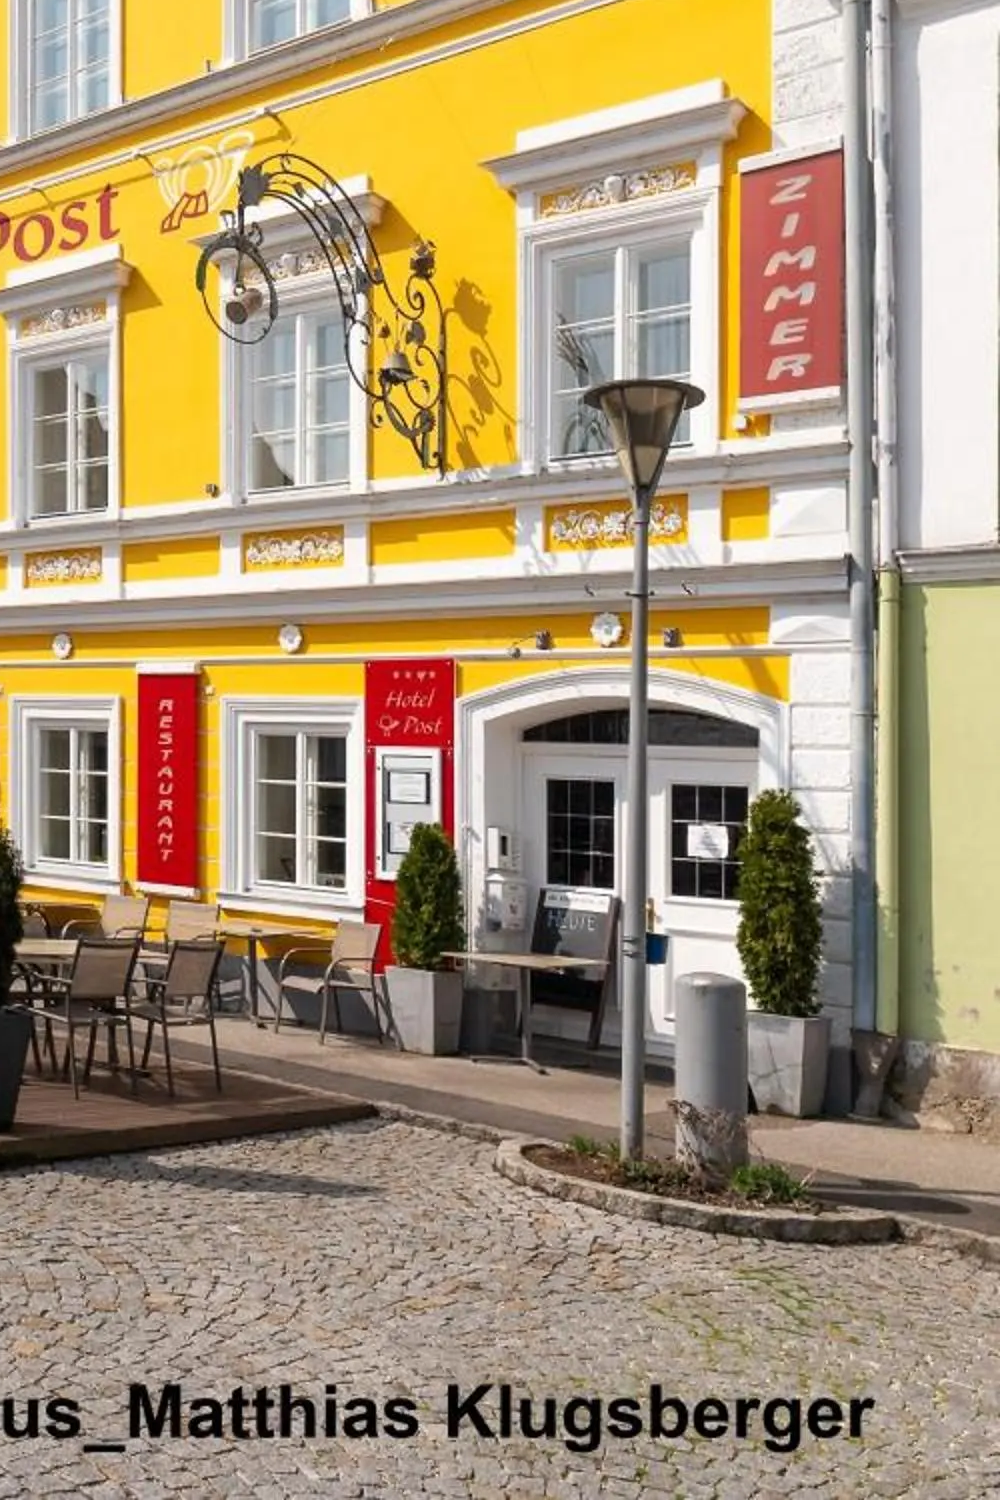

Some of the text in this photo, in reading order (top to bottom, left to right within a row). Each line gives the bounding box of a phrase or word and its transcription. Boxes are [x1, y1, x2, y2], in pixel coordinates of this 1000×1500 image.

[764, 174, 816, 381] ZIMMER
[385, 687, 436, 709] Hotel
[402, 715, 444, 737] Post
[157, 699, 174, 863] RESTAURANT
